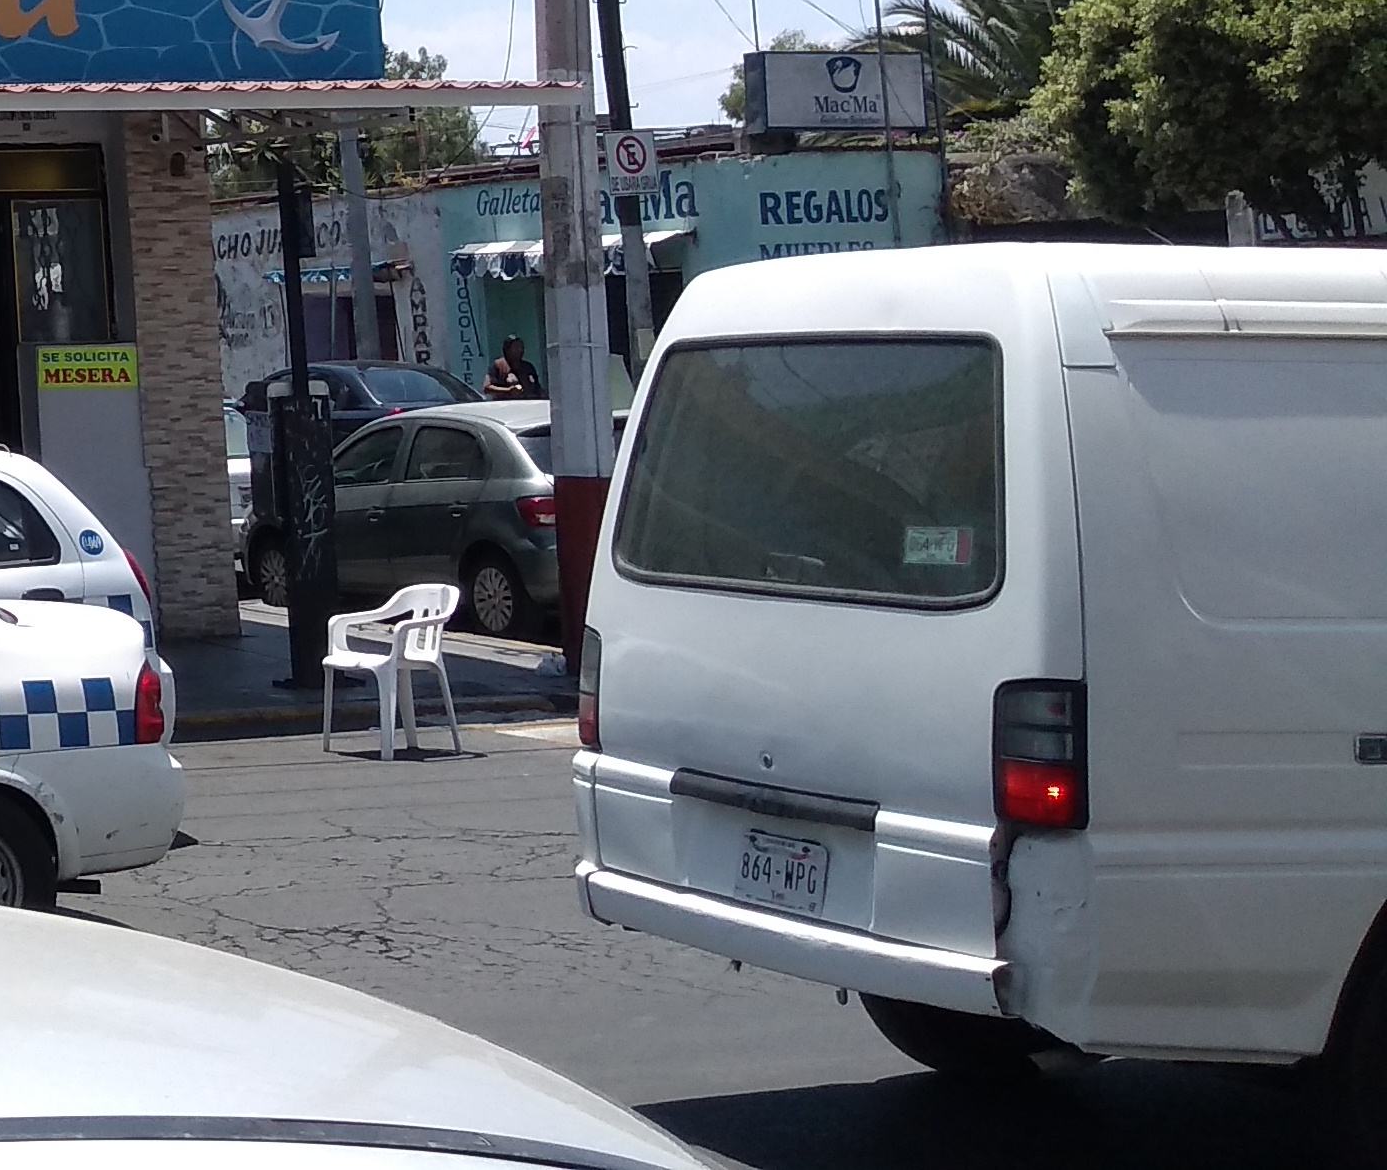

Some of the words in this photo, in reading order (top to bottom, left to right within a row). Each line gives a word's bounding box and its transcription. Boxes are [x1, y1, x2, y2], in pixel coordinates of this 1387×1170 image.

[476, 186, 541, 217] Galleta
[759, 188, 889, 226] REGALOS
[41, 352, 60, 363] SE
[64, 351, 130, 363] SOLICITA
[44, 367, 132, 384] MESERA
[741, 852, 818, 895] 864-WPG
